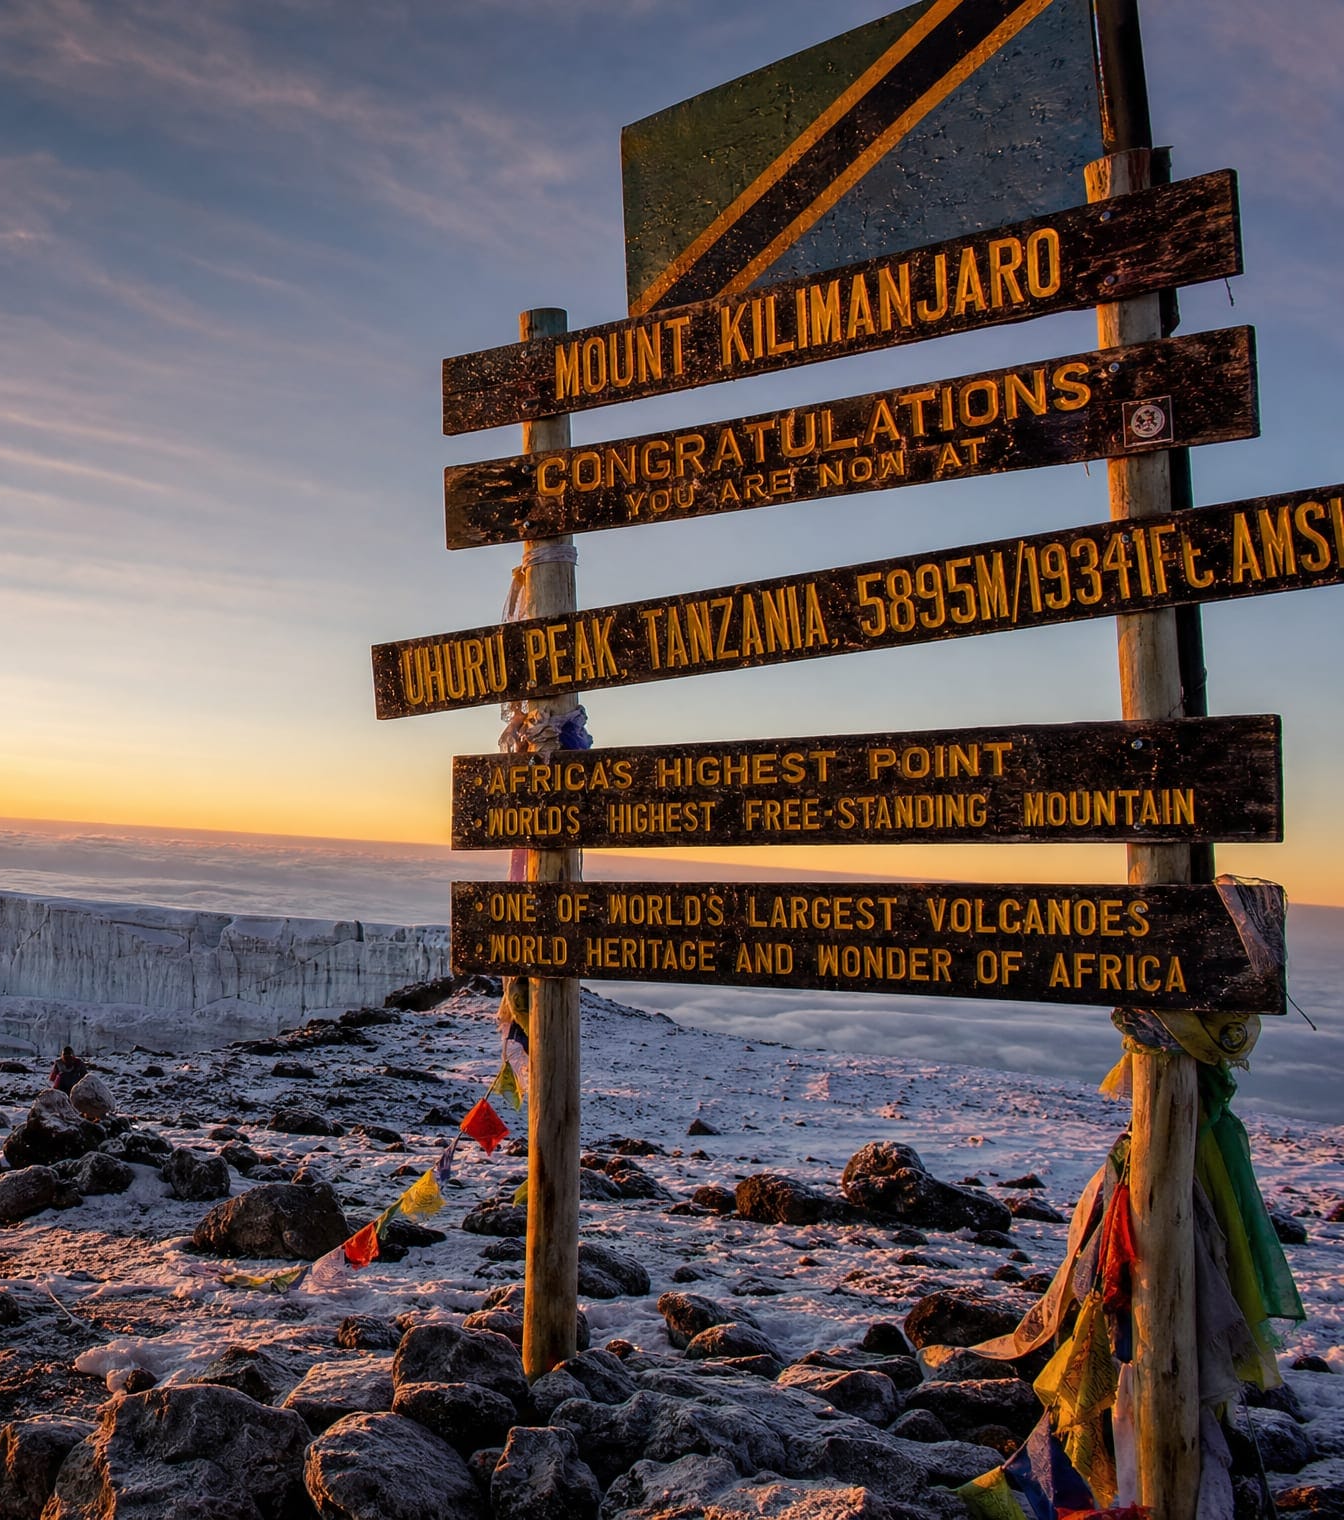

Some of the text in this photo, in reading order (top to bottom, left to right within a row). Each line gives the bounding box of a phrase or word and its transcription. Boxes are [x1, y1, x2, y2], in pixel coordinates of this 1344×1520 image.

[555, 226, 1062, 399] MOUNT KILIMANJARO
[536, 360, 1092, 498] CONGRATULATIONS
[626, 436, 987, 516] YOU ARE NOW AT
[401, 633, 509, 705] UHURU
[525, 615, 630, 687] PEAK,
[640, 582, 839, 672] TANZANIA,
[488, 742, 1013, 795] AFRICA'S HIGHEST POINT
[488, 788, 1196, 836] WORLD'S HIGHEST FREE-STANDING MOUNTAIN
[489, 894, 1151, 937] ONE OF WORLD'S LARGEST VOLCANOES
[489, 934, 1188, 994] WORLD HERITAGE AND WONDER OF AFRICA
